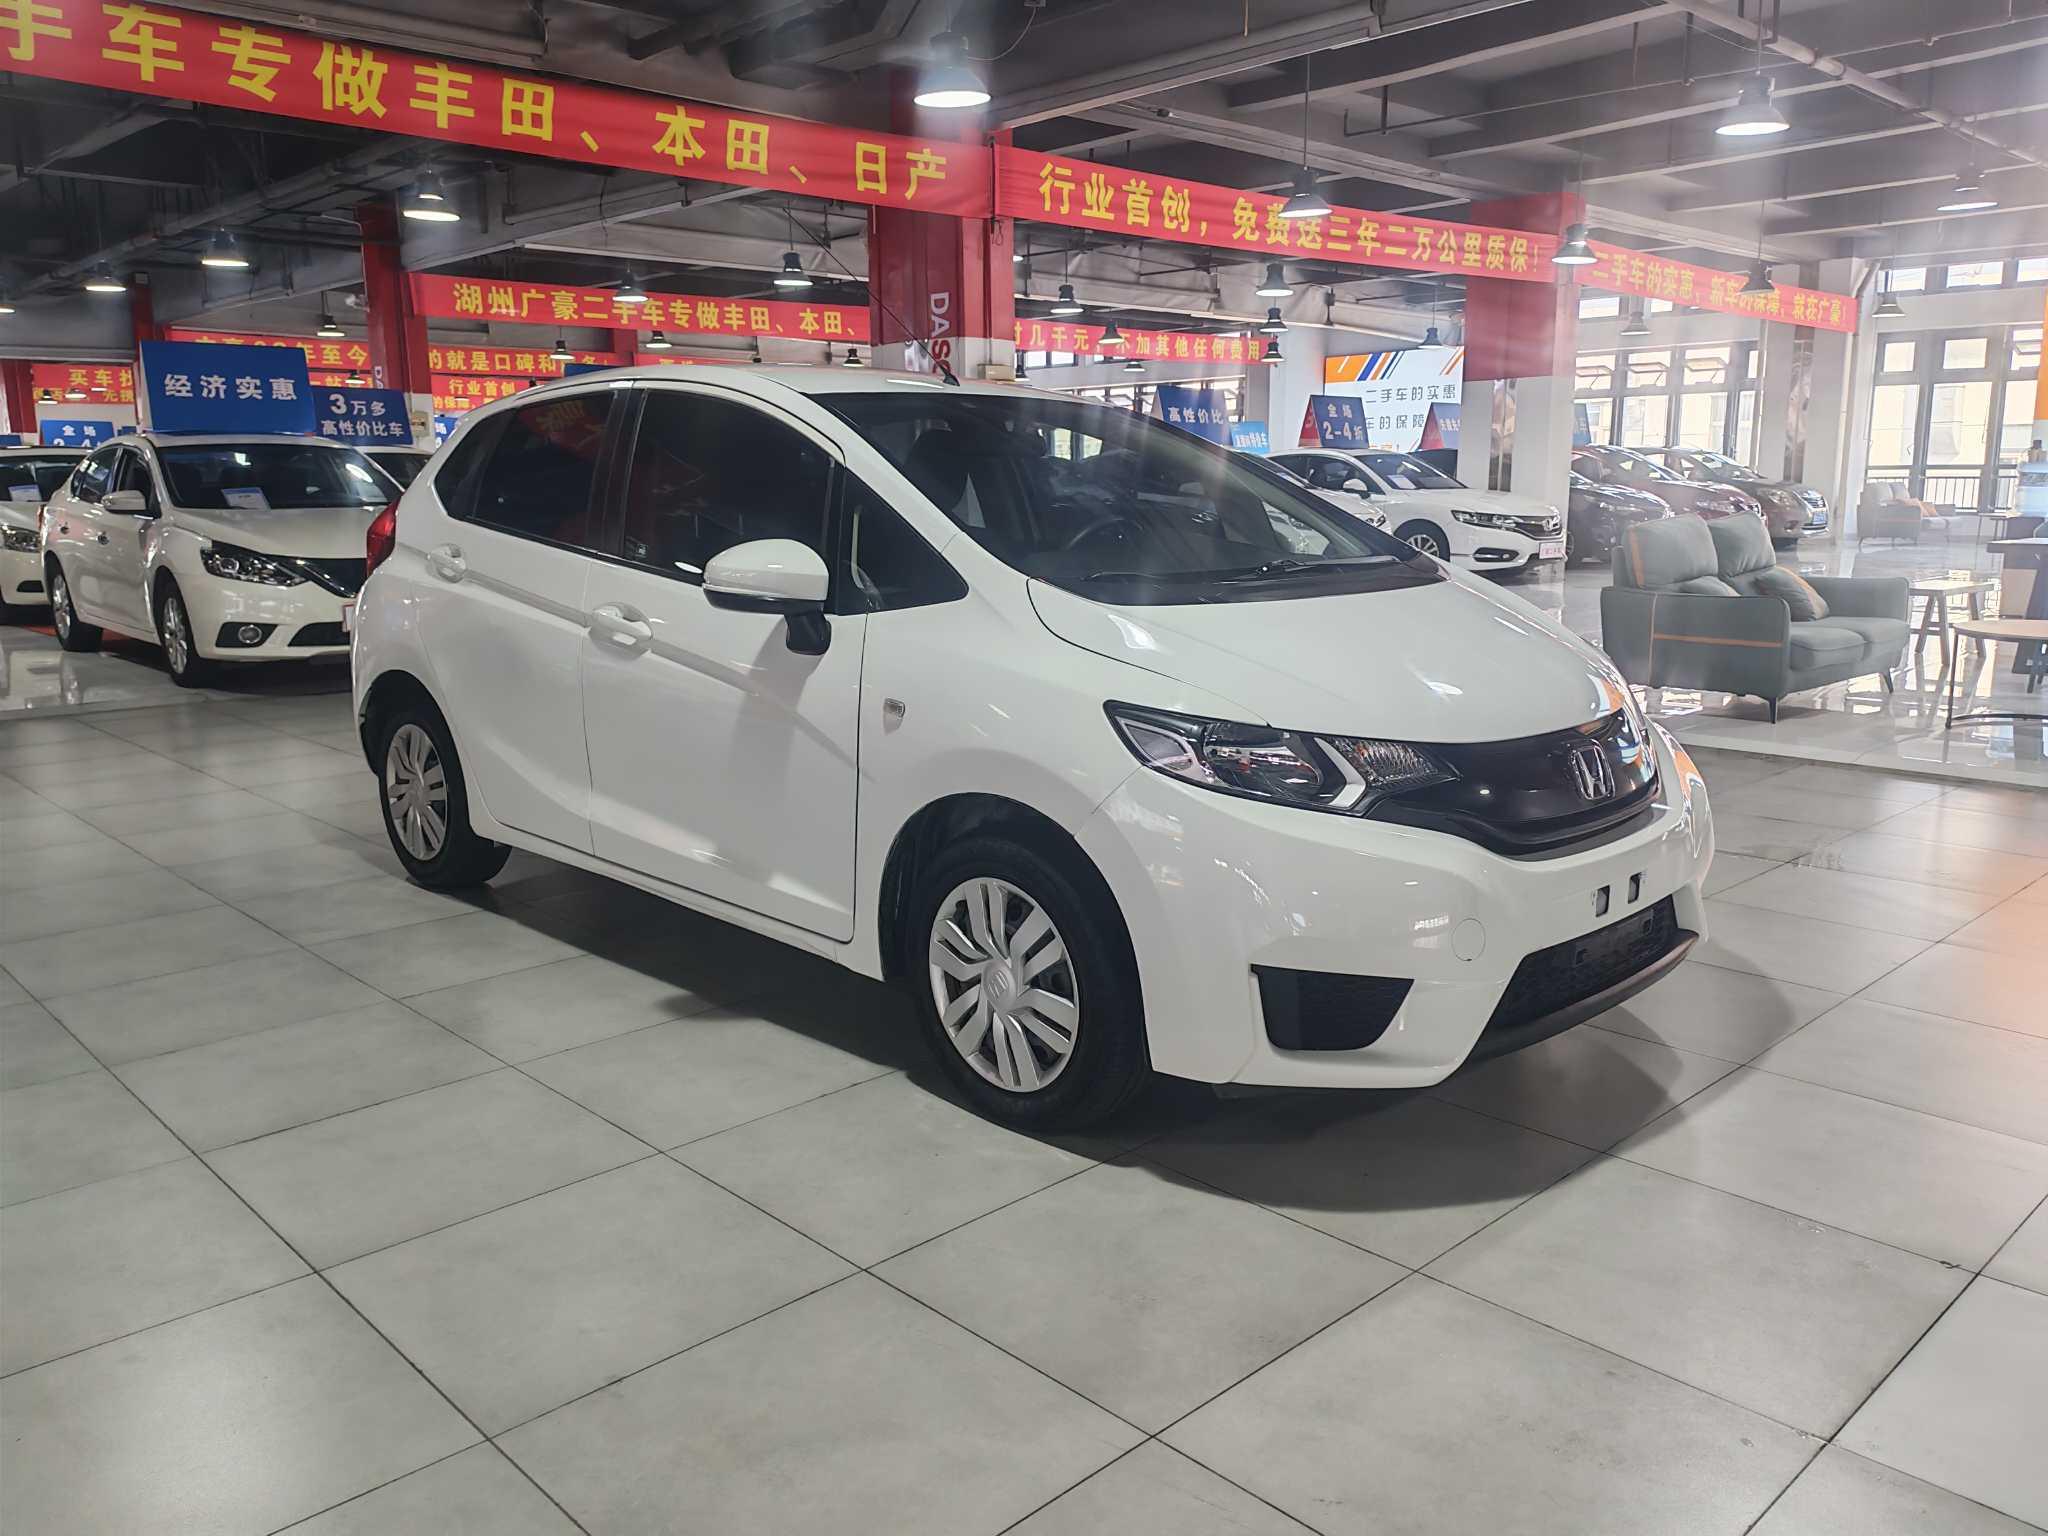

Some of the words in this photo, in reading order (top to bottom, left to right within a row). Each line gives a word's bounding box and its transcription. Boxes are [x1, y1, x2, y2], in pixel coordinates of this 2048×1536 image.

[164, 374, 298, 401] 经济实惠
[1365, 384, 1456, 404] 二手车的实惠
[329, 394, 386, 417] 3万多
[1168, 407, 1224, 424] 高性价比
[321, 420, 405, 437] 高性价比车
